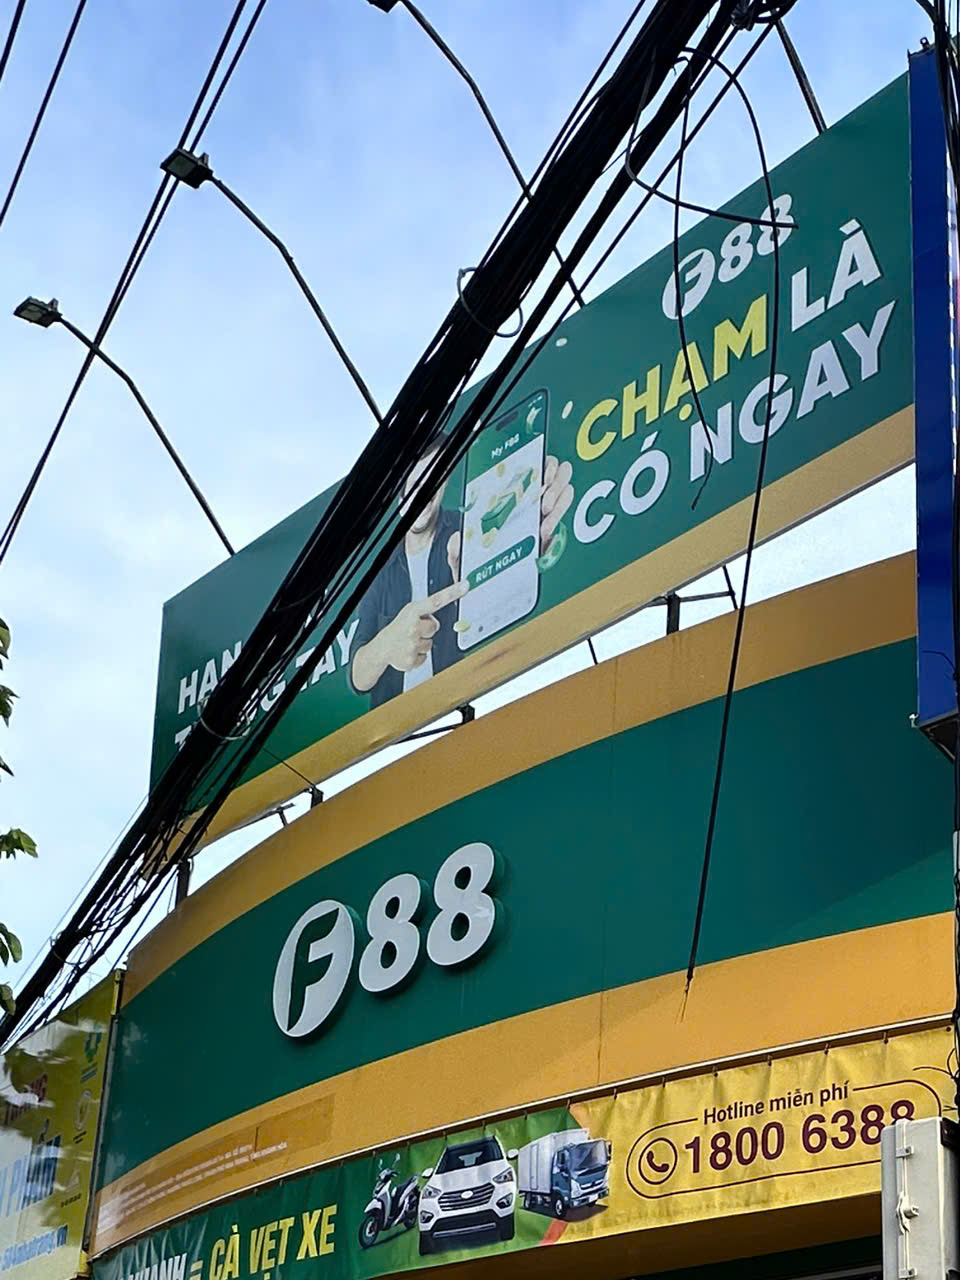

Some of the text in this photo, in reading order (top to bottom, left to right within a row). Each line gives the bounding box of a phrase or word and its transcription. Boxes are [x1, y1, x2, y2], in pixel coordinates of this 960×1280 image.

[662, 194, 793, 319] F88
[576, 219, 881, 461] CHẠM LÀ
[573, 301, 896, 543] CÓ NGAY
[273, 842, 495, 1037] F88
[685, 1121, 785, 1174] 1800
[703, 1080, 850, 1125] Hotline miễn phí
[249, 1216, 295, 1280] VẸT
[297, 1204, 338, 1261] XE
